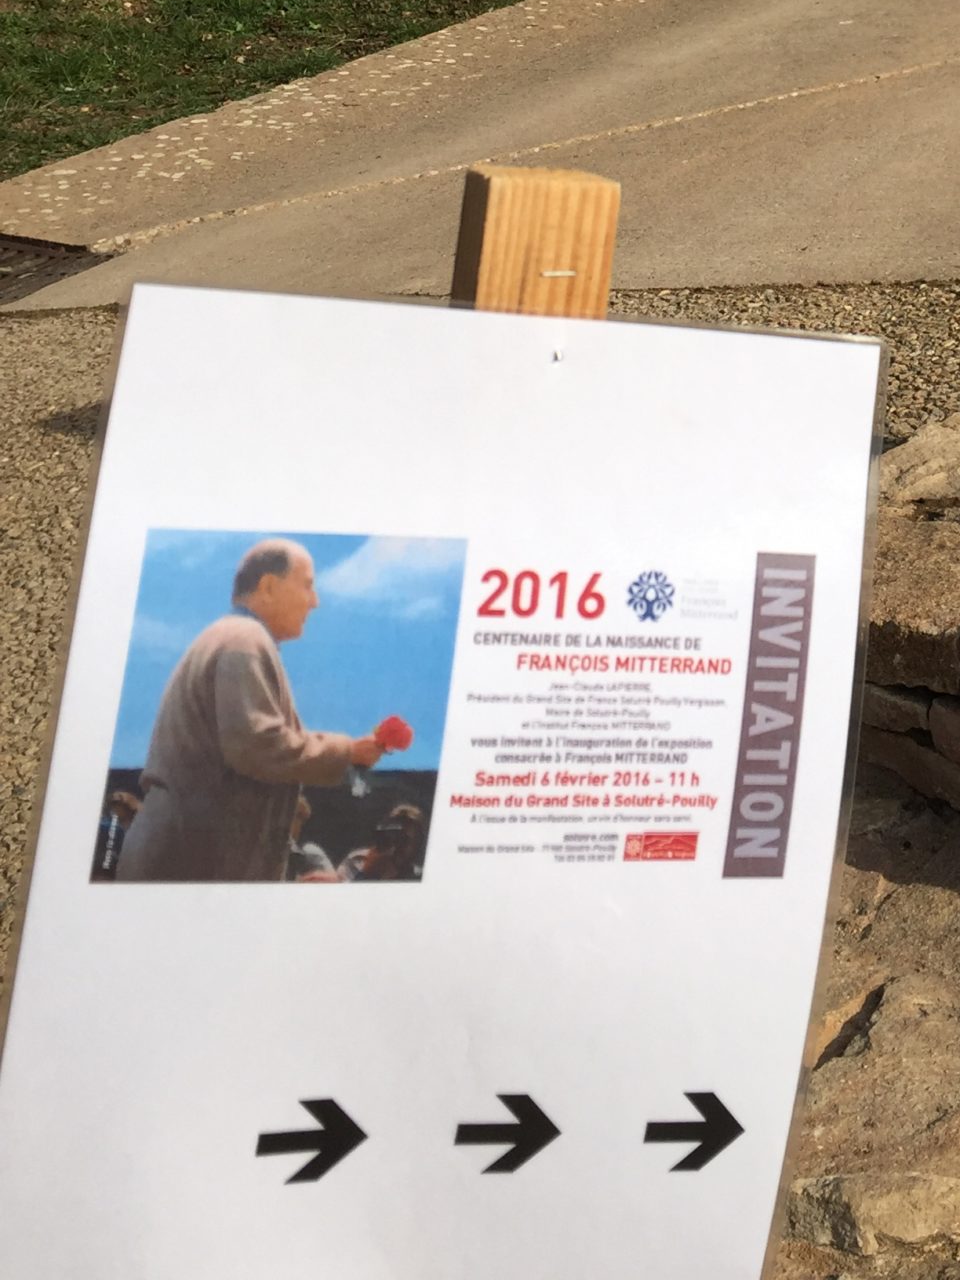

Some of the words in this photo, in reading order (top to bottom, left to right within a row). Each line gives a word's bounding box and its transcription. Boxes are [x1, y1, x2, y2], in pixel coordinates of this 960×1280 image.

[476, 569, 606, 620] 2016
[474, 632, 561, 647] CENTENAIRE
[566, 635, 582, 648] DE
[586, 636, 603, 648] LA
[606, 637, 681, 649] NAISSANCE
[684, 638, 701, 650] DE
[516, 654, 609, 677] FRANÇOIS
[614, 657, 732, 674] MITTERRAND
[733, 569, 807, 859] INVITATION
[470, 737, 498, 748] vous
[500, 737, 542, 747] invitent
[546, 737, 552, 747] à
[555, 737, 634, 750] l'inauguration
[636, 738, 648, 748] de
[652, 738, 712, 751] l'exposition
[555, 752, 561, 763] à
[565, 752, 612, 764] François
[615, 753, 687, 764] MITTERRAND
[475, 773, 536, 787] Samedi
[541, 774, 549, 786] 6
[554, 772, 608, 786] février
[612, 773, 650, 786] 2016
[669, 773, 685, 786] 11
[690, 773, 699, 786] h
[450, 795, 500, 808] Maison
[504, 795, 522, 807] du
[527, 795, 568, 807] Grand
[572, 795, 599, 807] Site
[602, 794, 610, 807] à
[614, 795, 718, 810] Solutré-Pouilly
